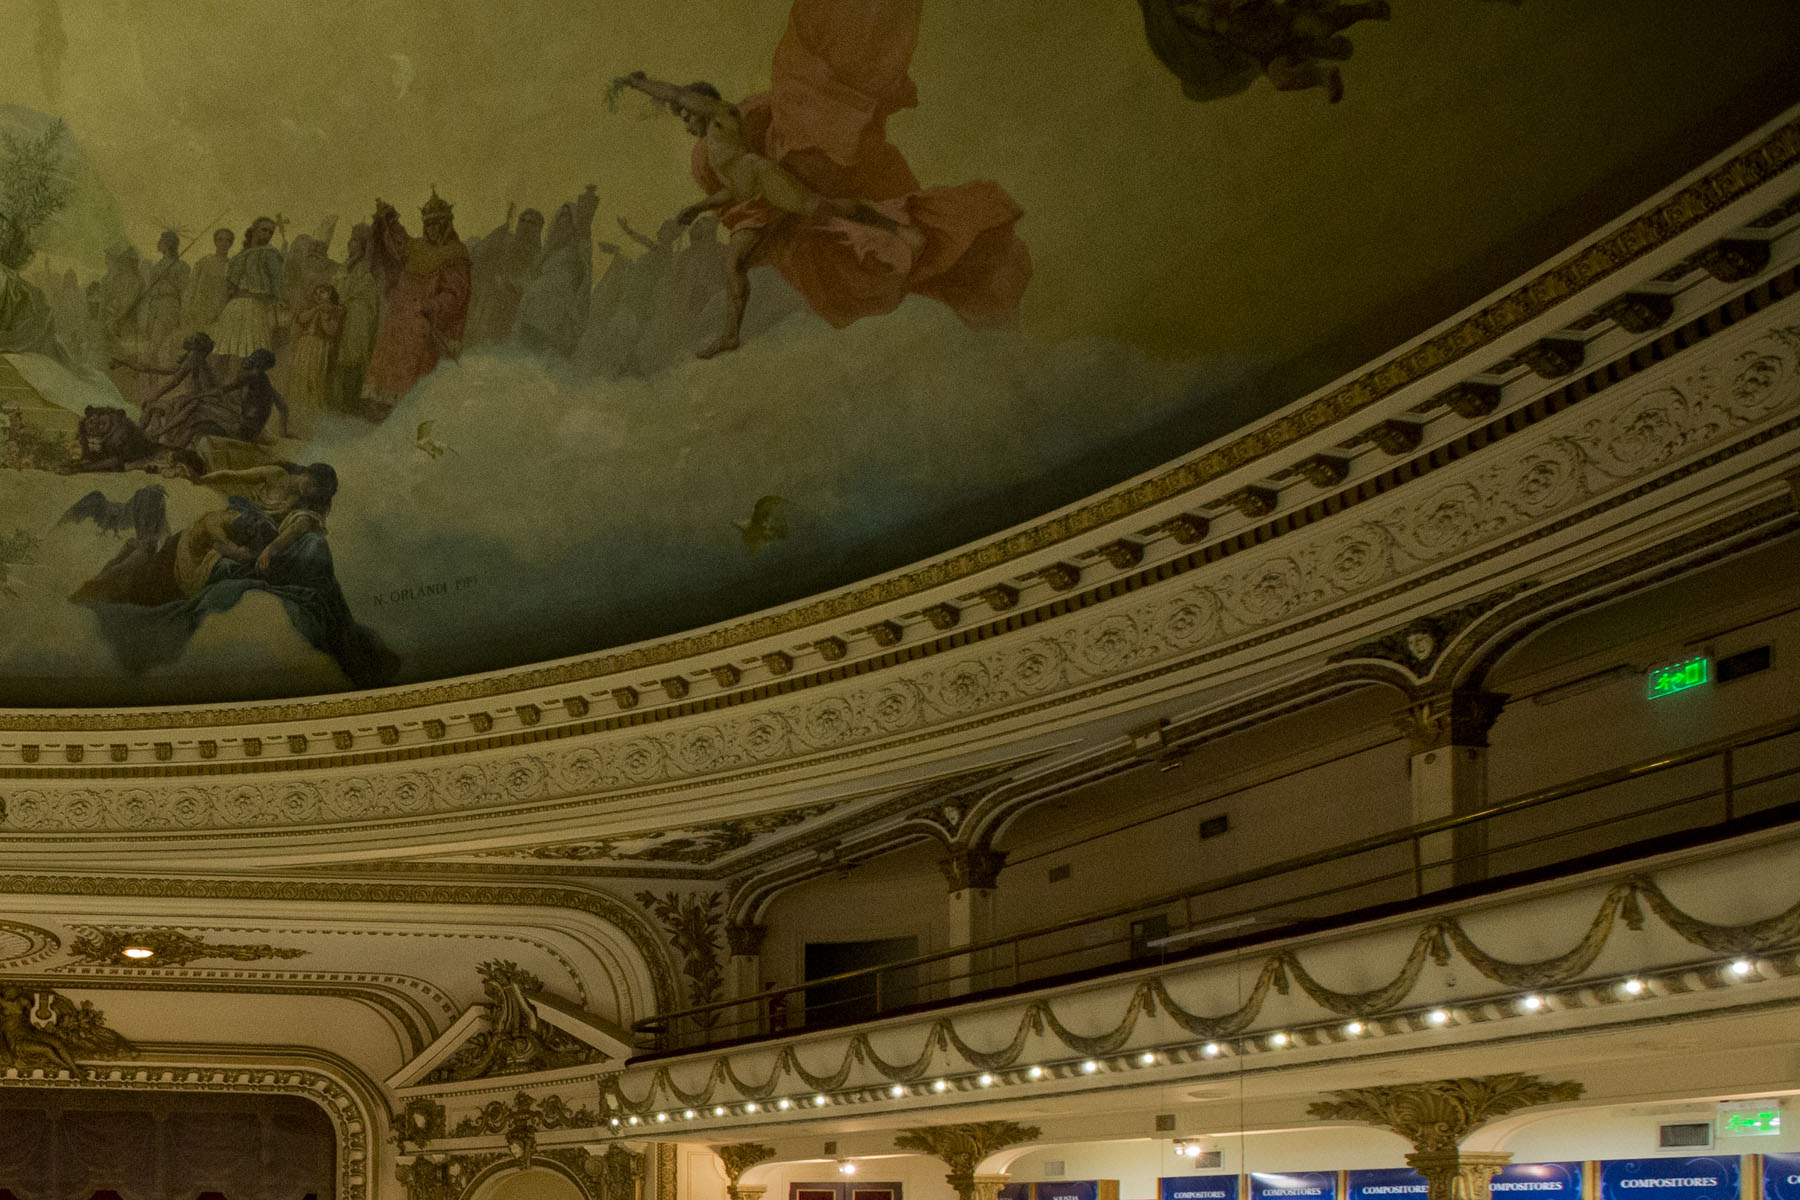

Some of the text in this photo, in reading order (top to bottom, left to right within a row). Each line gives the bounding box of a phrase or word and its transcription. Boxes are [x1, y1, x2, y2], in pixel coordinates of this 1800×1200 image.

[1488, 1181, 1563, 1191] OMPOSITORES
[1619, 1176, 1718, 1189] COMPOSITORES
[1173, 1190, 1226, 1199] COMPOSITORES
[1262, 1187, 1322, 1197] COMPOSITORES
[1362, 1184, 1429, 1195] COMPOSITORE
